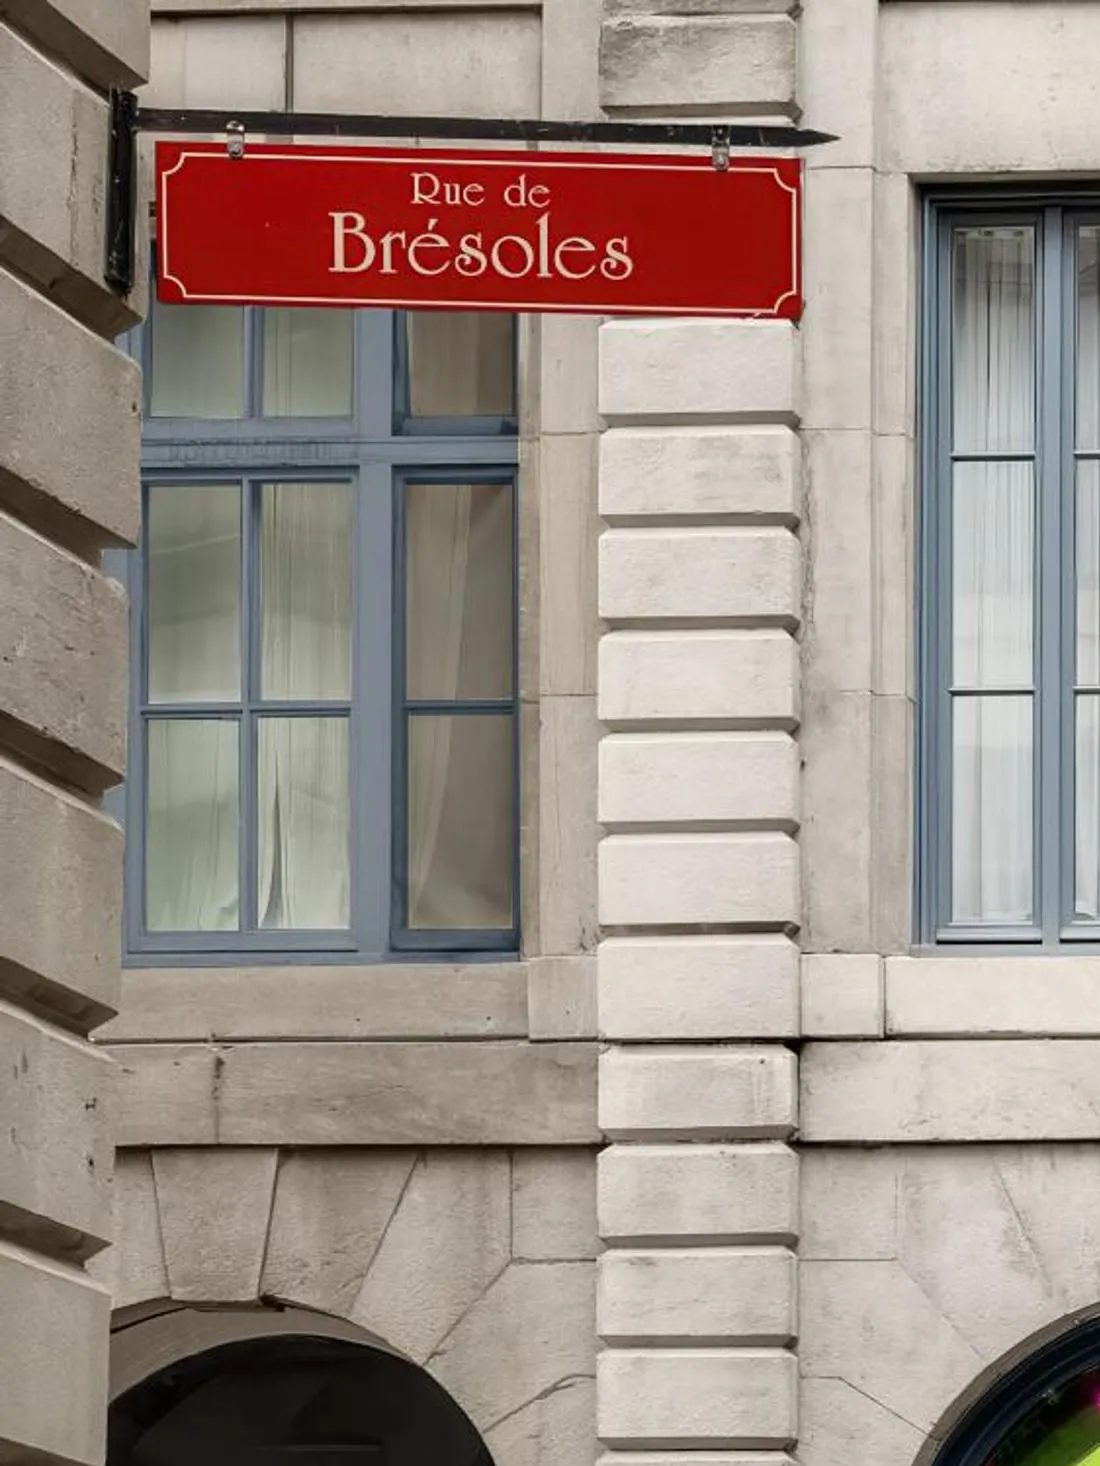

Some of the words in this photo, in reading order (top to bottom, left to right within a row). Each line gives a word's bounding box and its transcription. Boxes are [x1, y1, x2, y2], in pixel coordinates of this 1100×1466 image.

[411, 172, 485, 206] Rue
[503, 174, 551, 209] de
[328, 211, 634, 281] Brésoles
